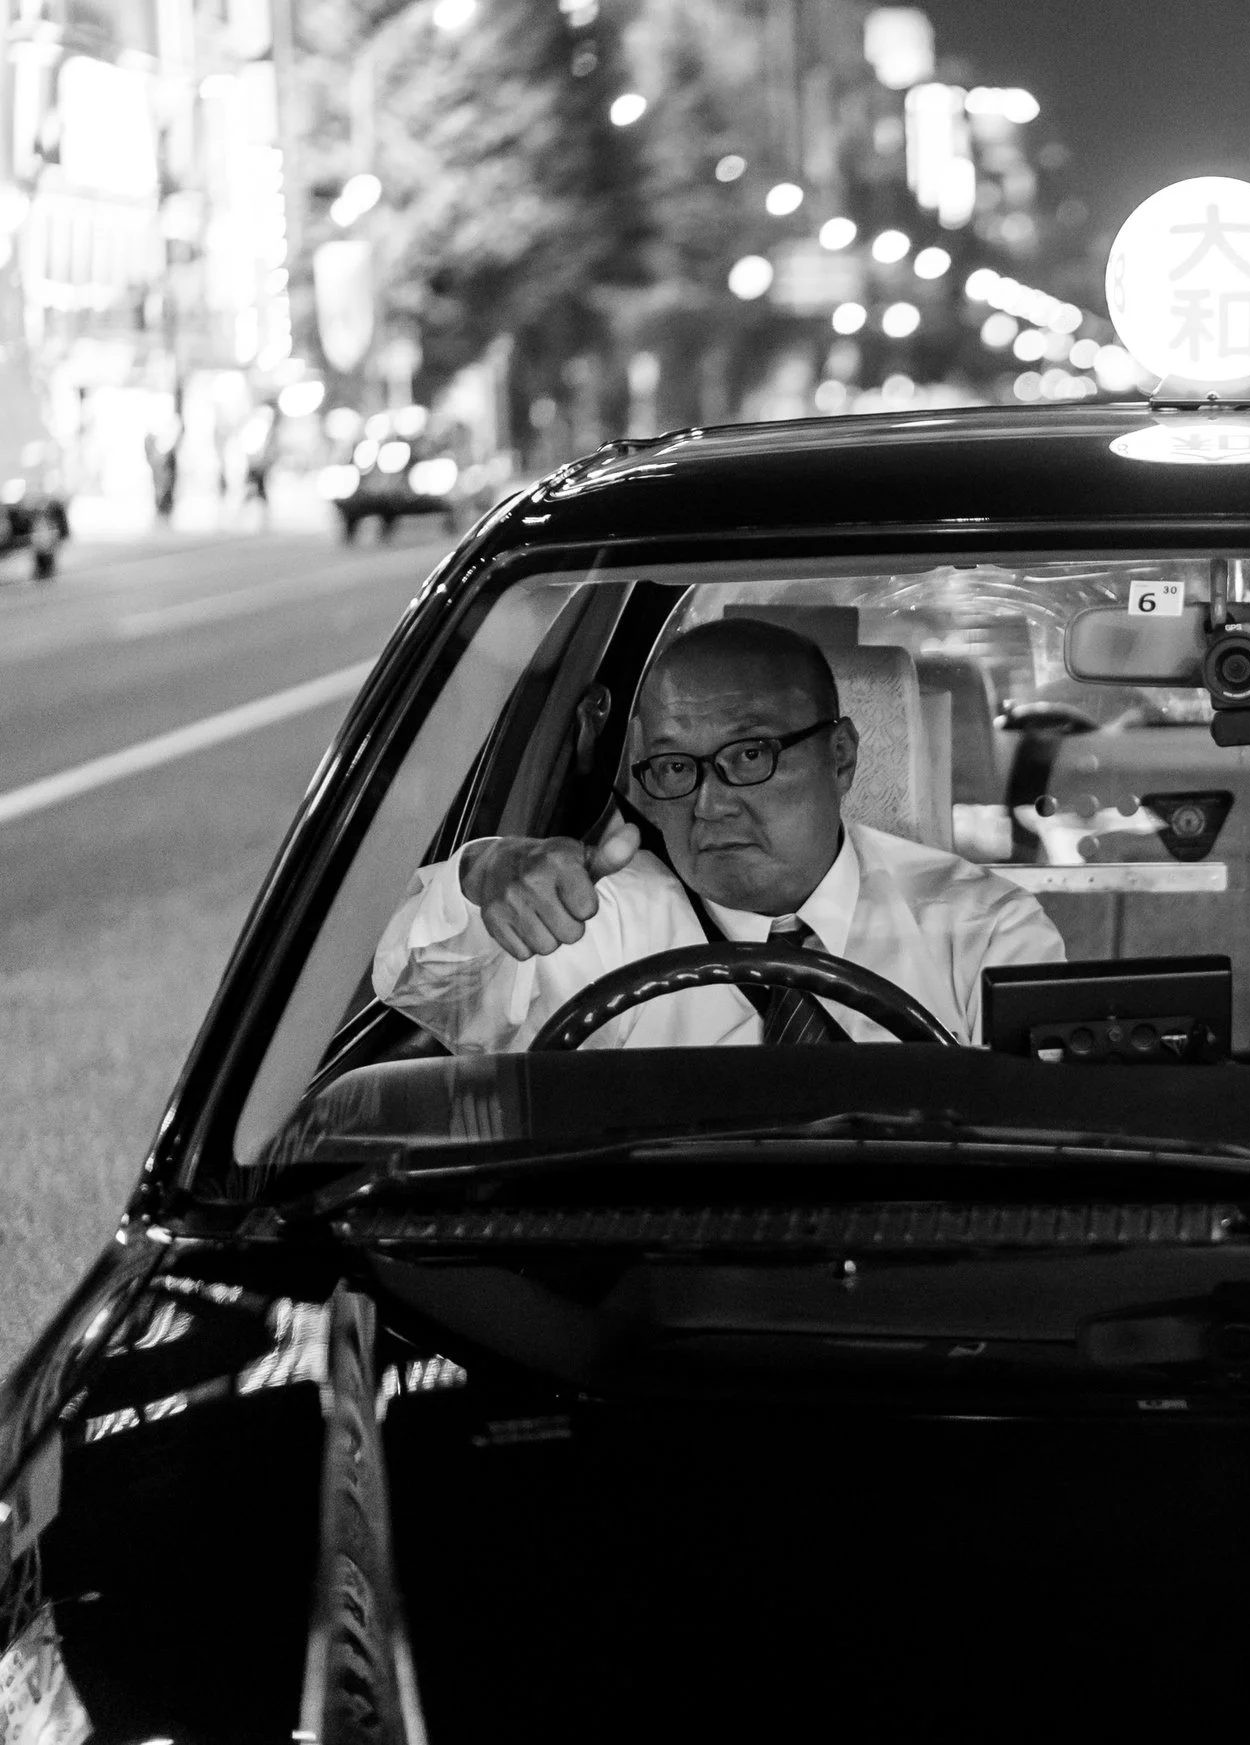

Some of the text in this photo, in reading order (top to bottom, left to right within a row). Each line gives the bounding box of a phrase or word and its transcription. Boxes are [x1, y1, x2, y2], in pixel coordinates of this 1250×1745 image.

[1163, 585, 1178, 595] 30
[1138, 592, 1156, 613] 6
[1224, 623, 1242, 632] GPS
